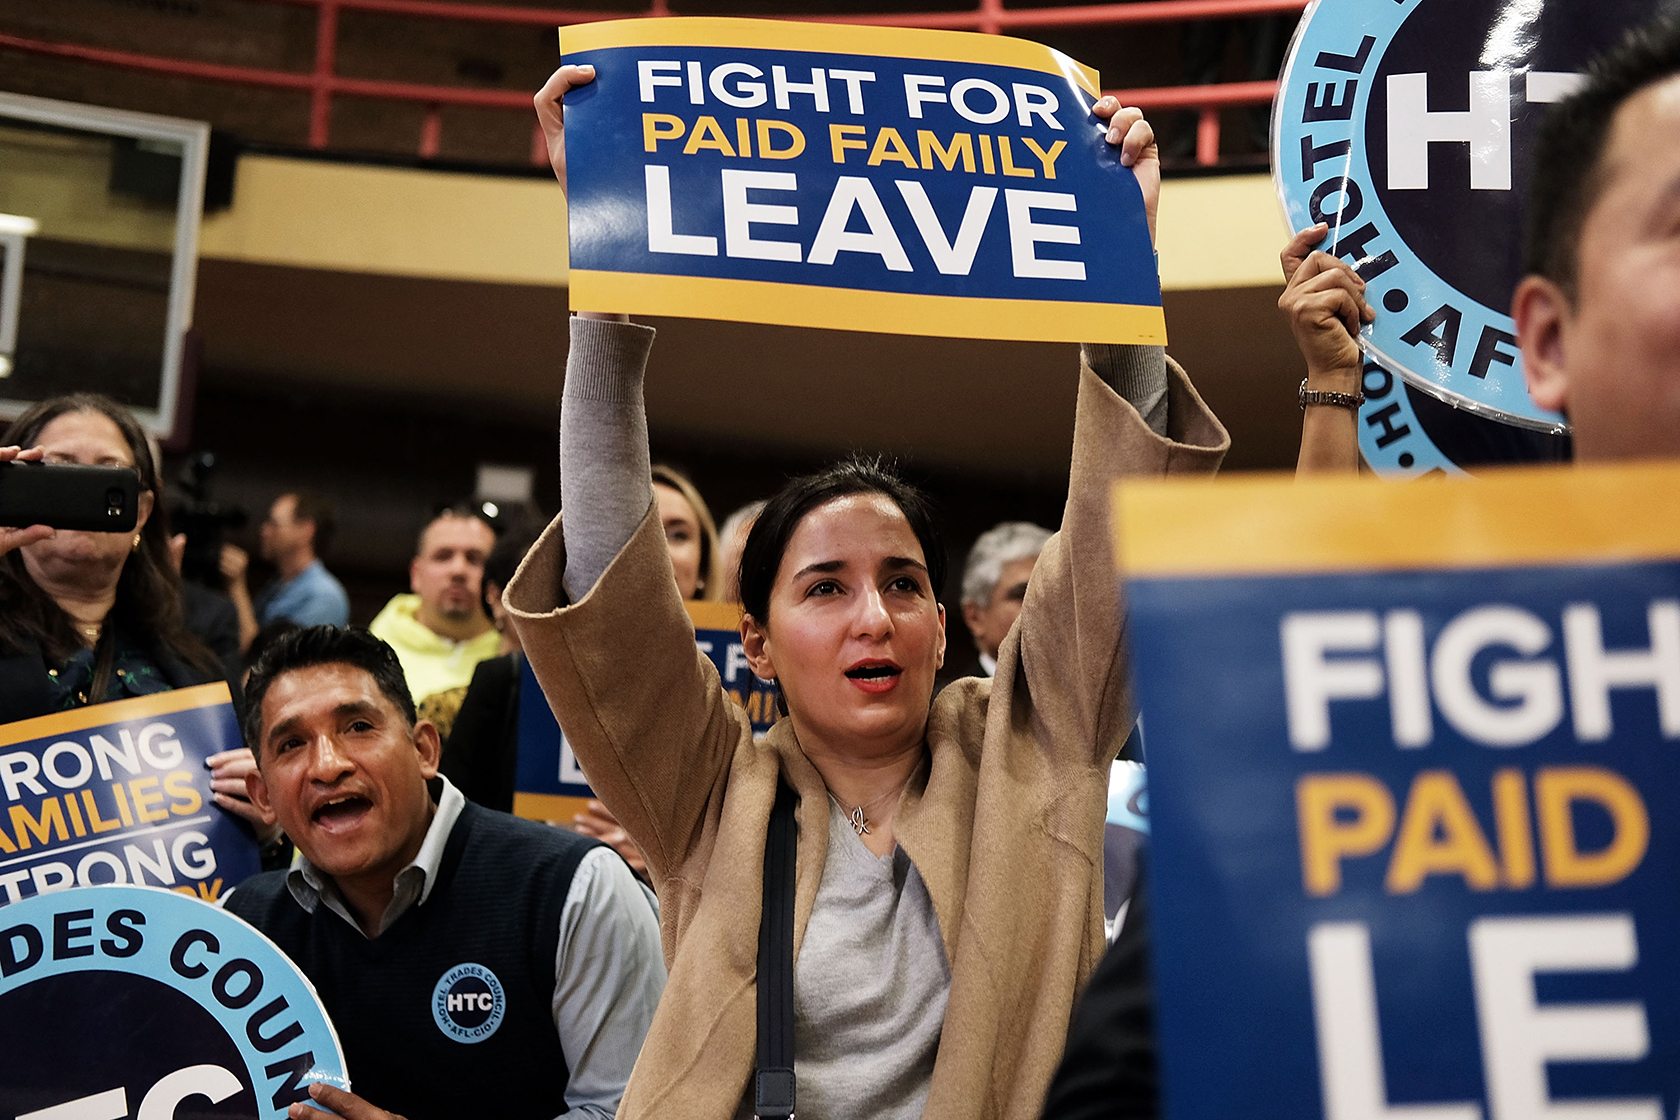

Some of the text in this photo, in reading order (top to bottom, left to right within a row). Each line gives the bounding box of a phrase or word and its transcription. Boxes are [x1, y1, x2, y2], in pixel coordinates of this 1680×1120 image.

[637, 60, 1065, 130] FIGHT FOR
[641, 113, 1068, 180] PAID FAMILY
[1300, 34, 1399, 284] HOTEL
[644, 165, 1087, 281] LEAVE
[1296, 766, 1650, 897] PAID
[437, 967, 503, 1025] HOTEL TRADES COUNCIL
[447, 992, 493, 1012] HTC
